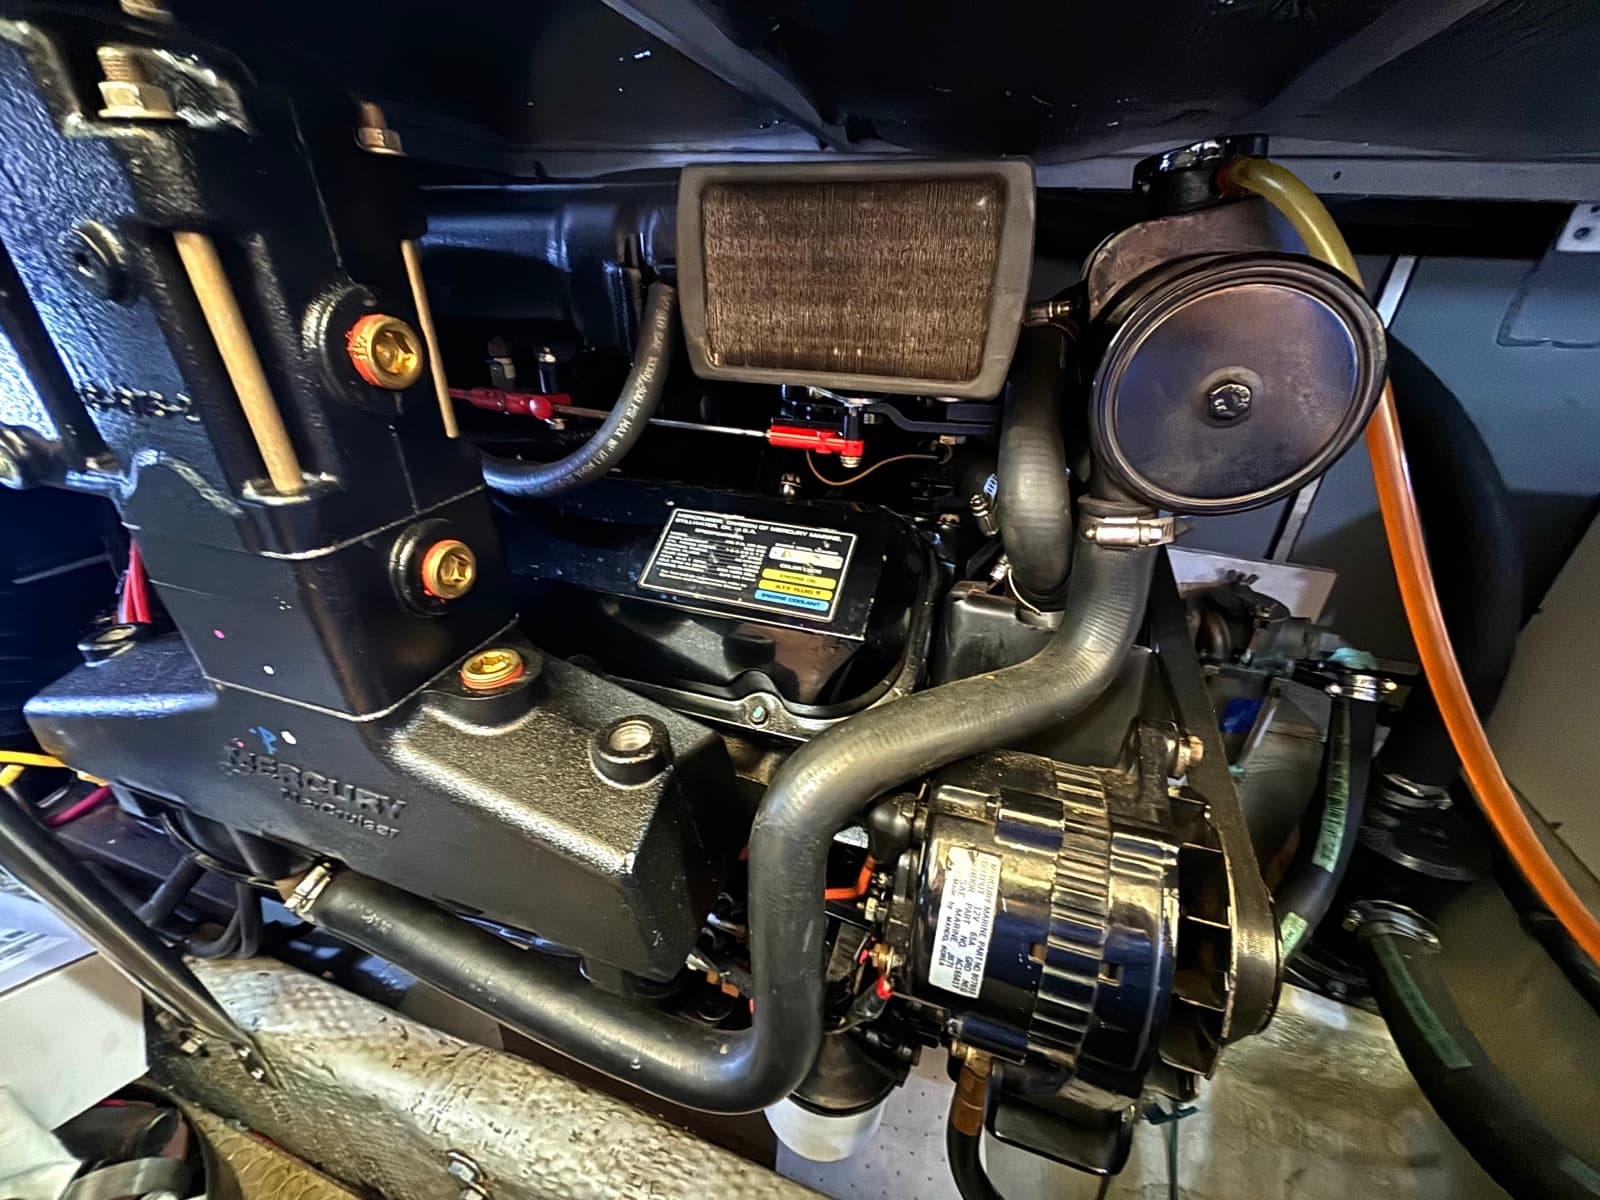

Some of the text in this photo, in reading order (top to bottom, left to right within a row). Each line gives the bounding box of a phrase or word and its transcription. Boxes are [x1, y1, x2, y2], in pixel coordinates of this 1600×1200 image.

[626, 403, 640, 418] PSI
[614, 419, 632, 438] MAX
[770, 526, 807, 536] MERCURY
[761, 593, 820, 607] ENGINE COOLANT
[229, 750, 407, 818] MERCURY
[947, 900, 954, 910] by
[963, 902, 972, 924] PART
[972, 906, 981, 922] 12V
[950, 908, 962, 943] MARINE
[979, 906, 990, 938] MARINE
[975, 941, 985, 961] PART
[963, 955, 973, 972] GRD
